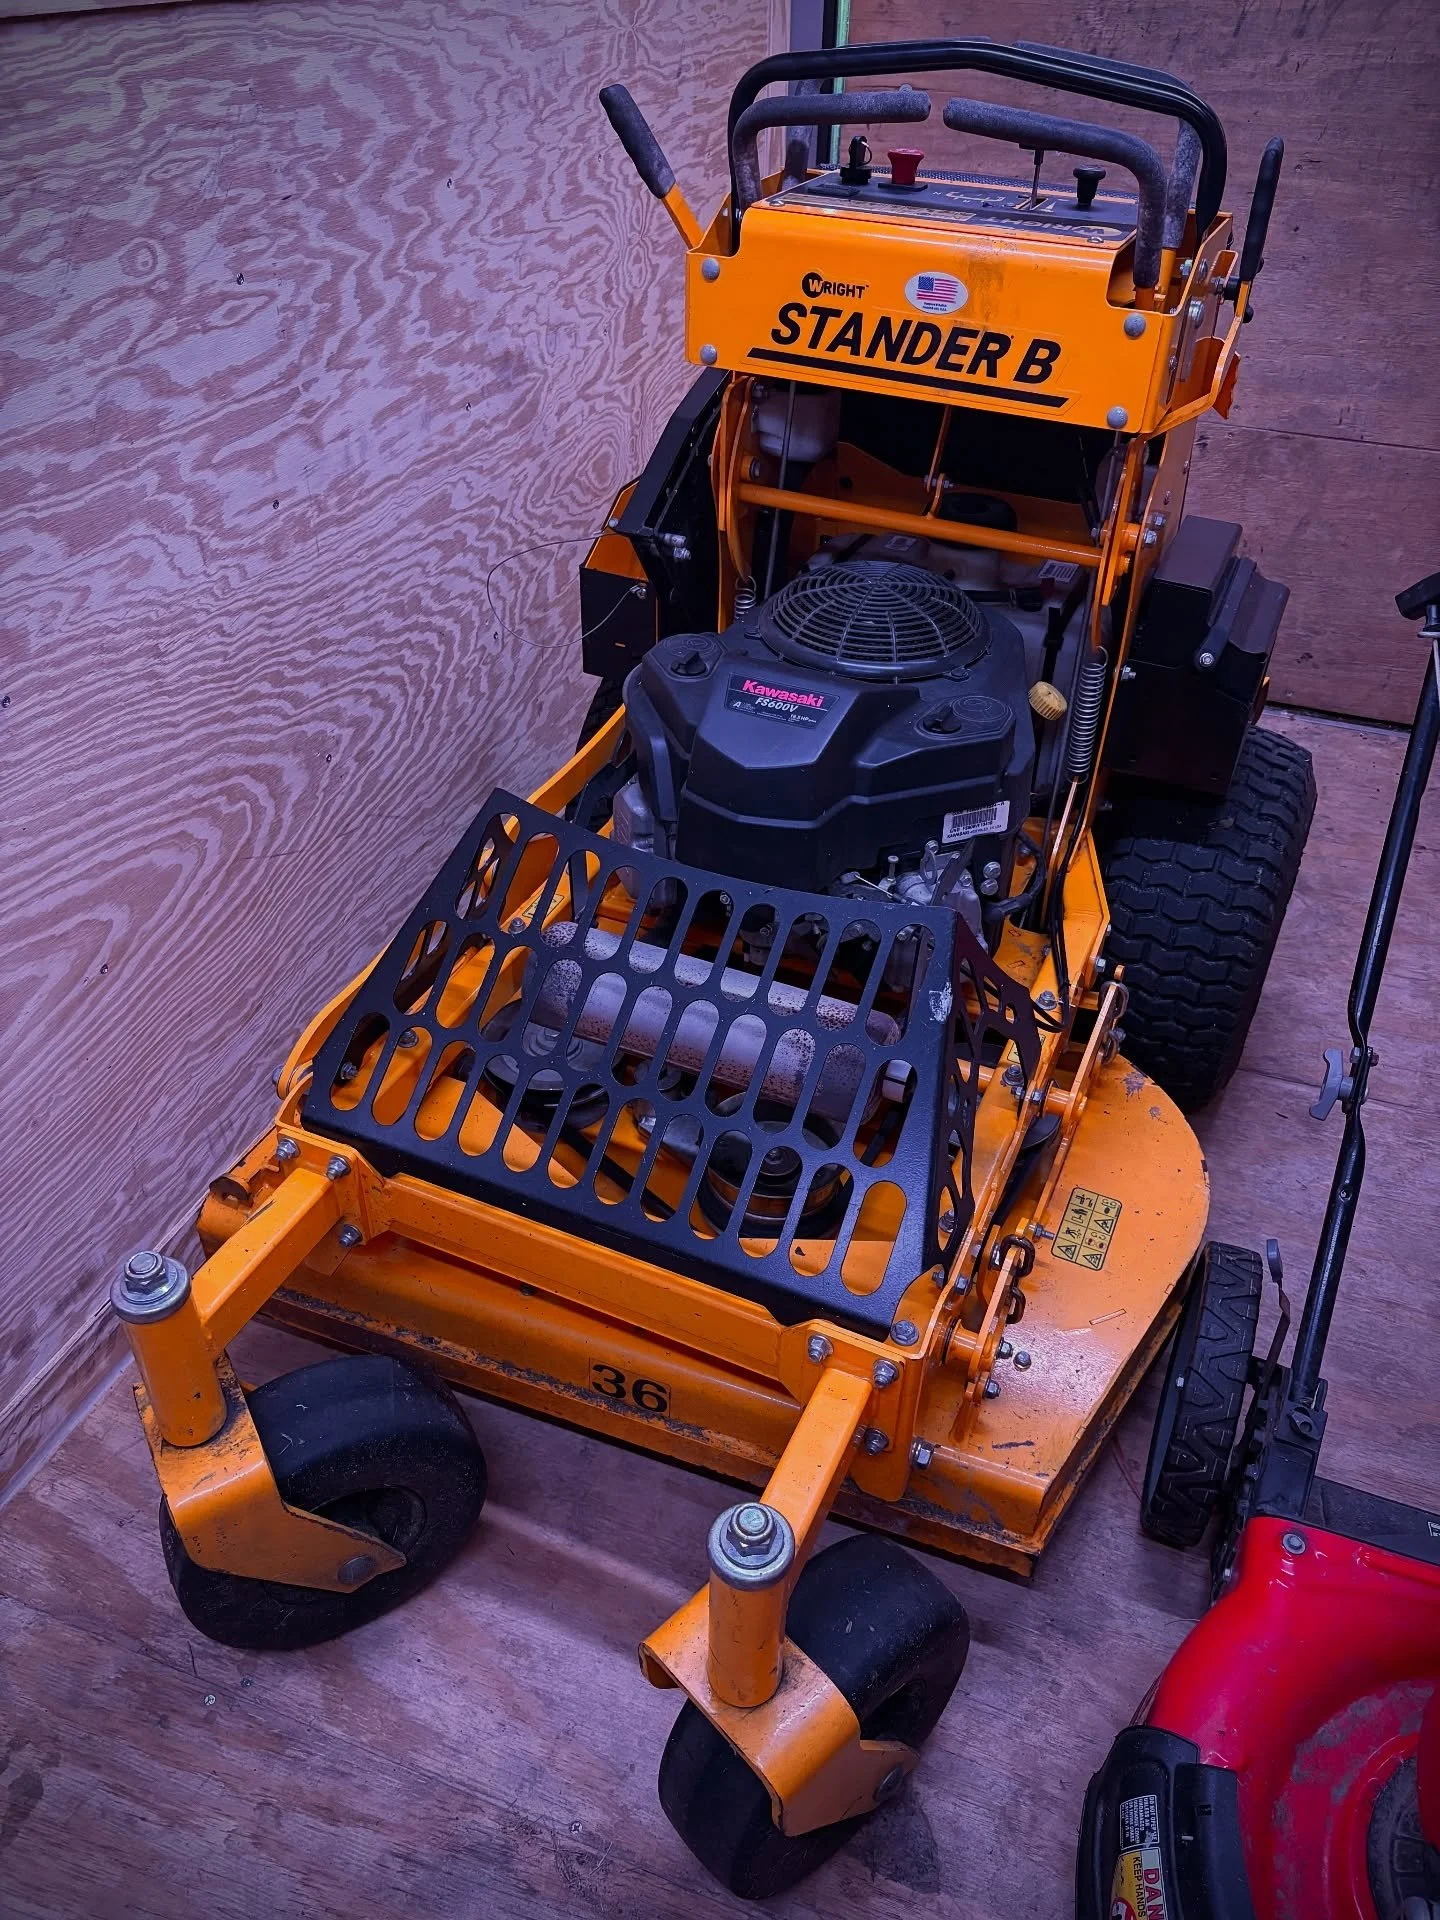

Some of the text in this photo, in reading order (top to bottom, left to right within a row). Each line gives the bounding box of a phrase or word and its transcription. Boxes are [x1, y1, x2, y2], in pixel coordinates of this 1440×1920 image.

[801, 271, 866, 299] WRIGHT
[770, 302, 1062, 384] STANDER B
[742, 680, 824, 707] Kawasaki
[755, 698, 799, 712] FS600V
[591, 1364, 668, 1412] 36
[1132, 1856, 1146, 1918] KEEP HANDS
